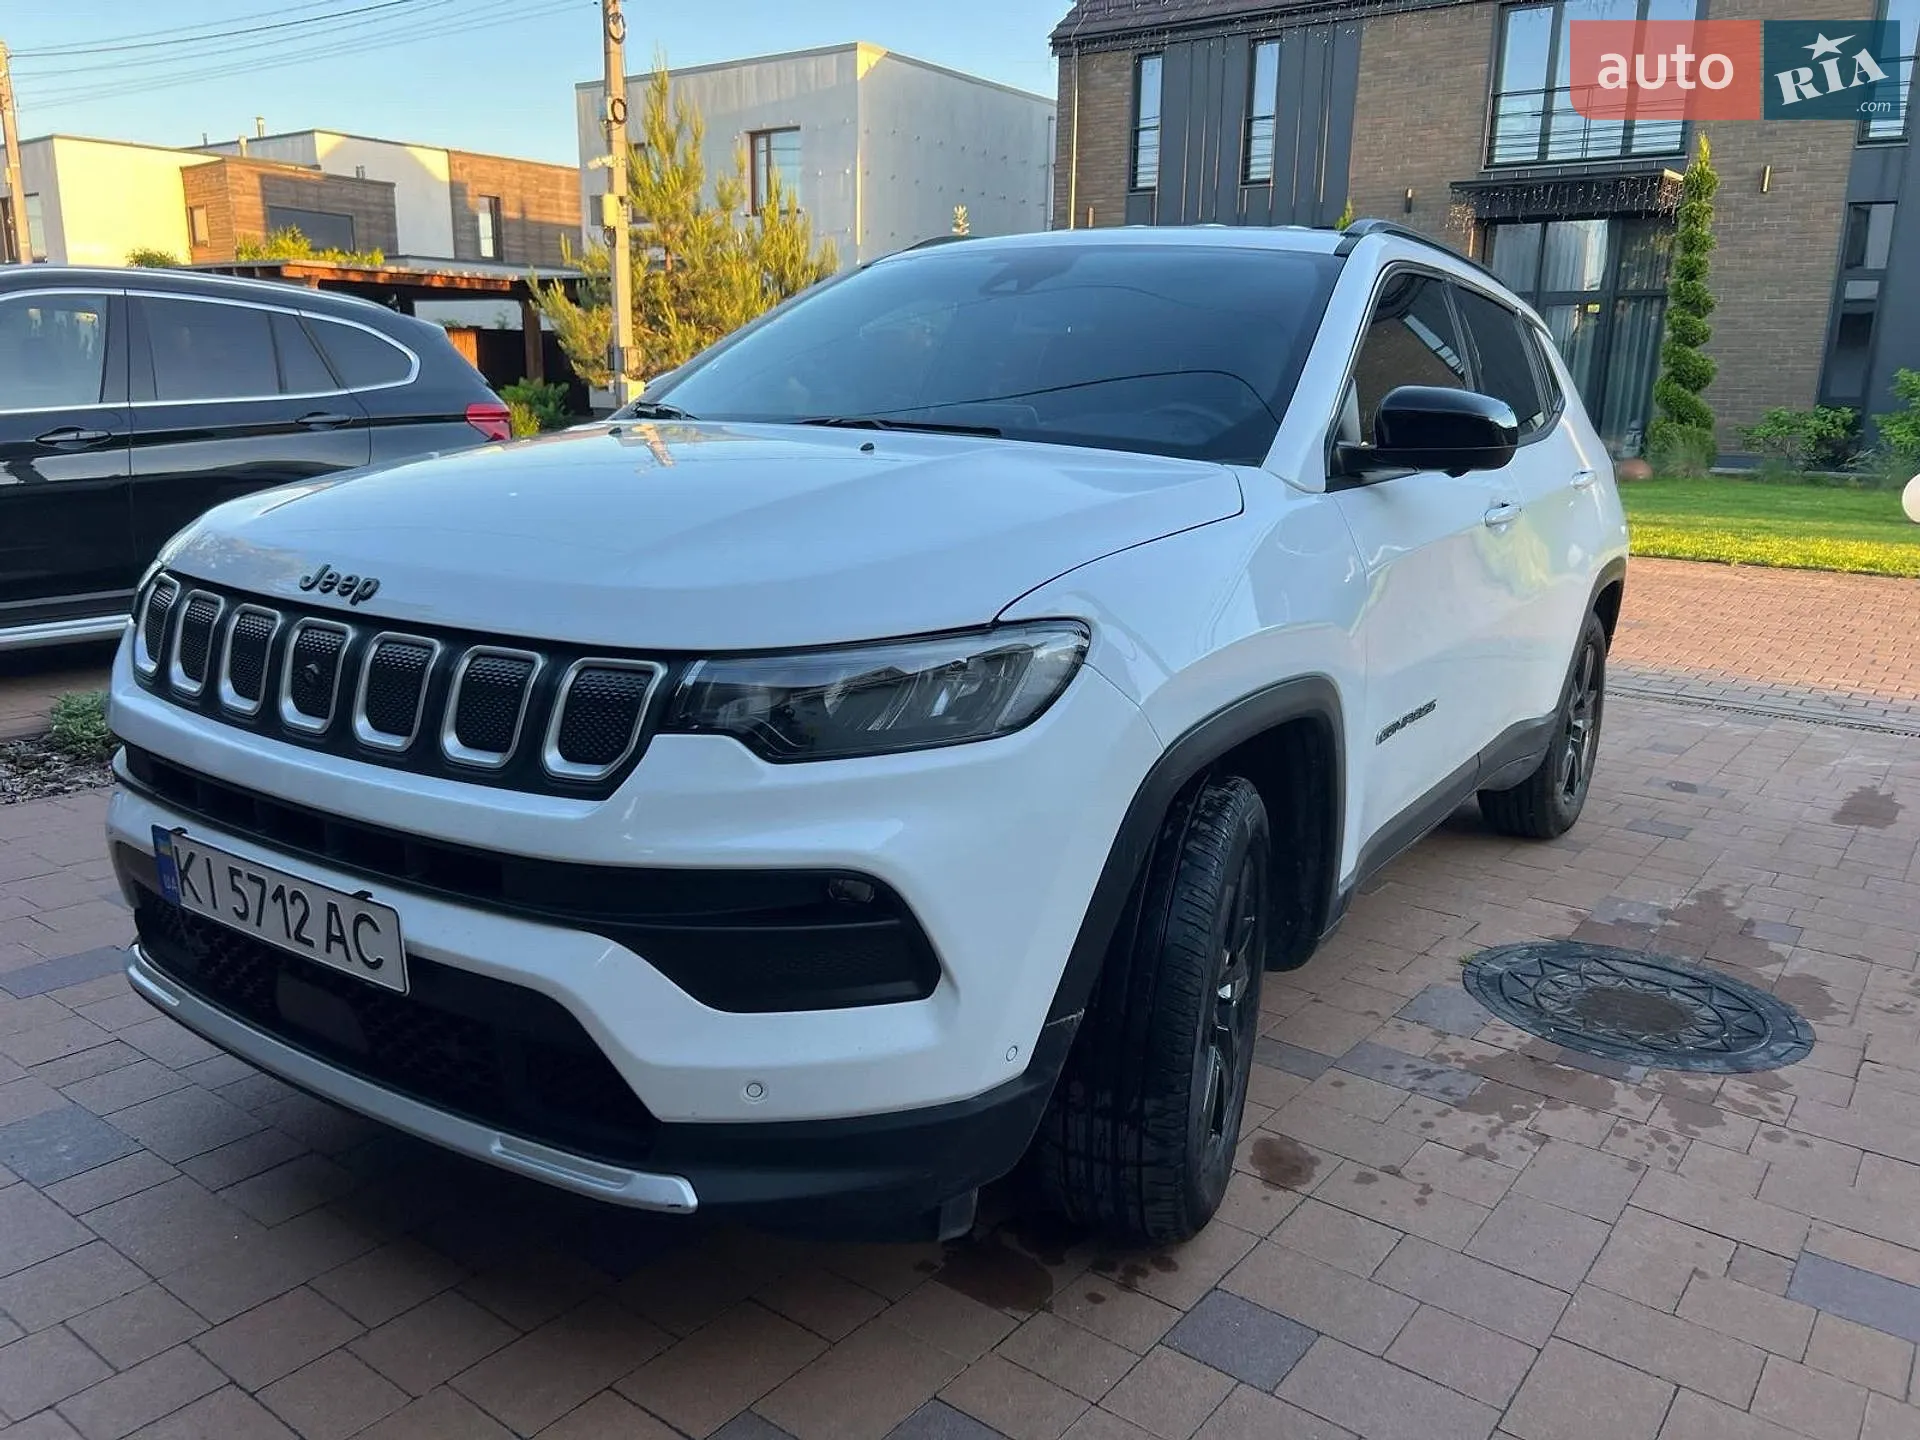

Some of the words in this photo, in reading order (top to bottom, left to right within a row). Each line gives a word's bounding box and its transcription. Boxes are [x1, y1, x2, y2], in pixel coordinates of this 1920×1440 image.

[299, 563, 380, 606] Jeep
[174, 845, 218, 909] KI
[228, 866, 315, 948] 5712
[325, 900, 385, 970] AC
